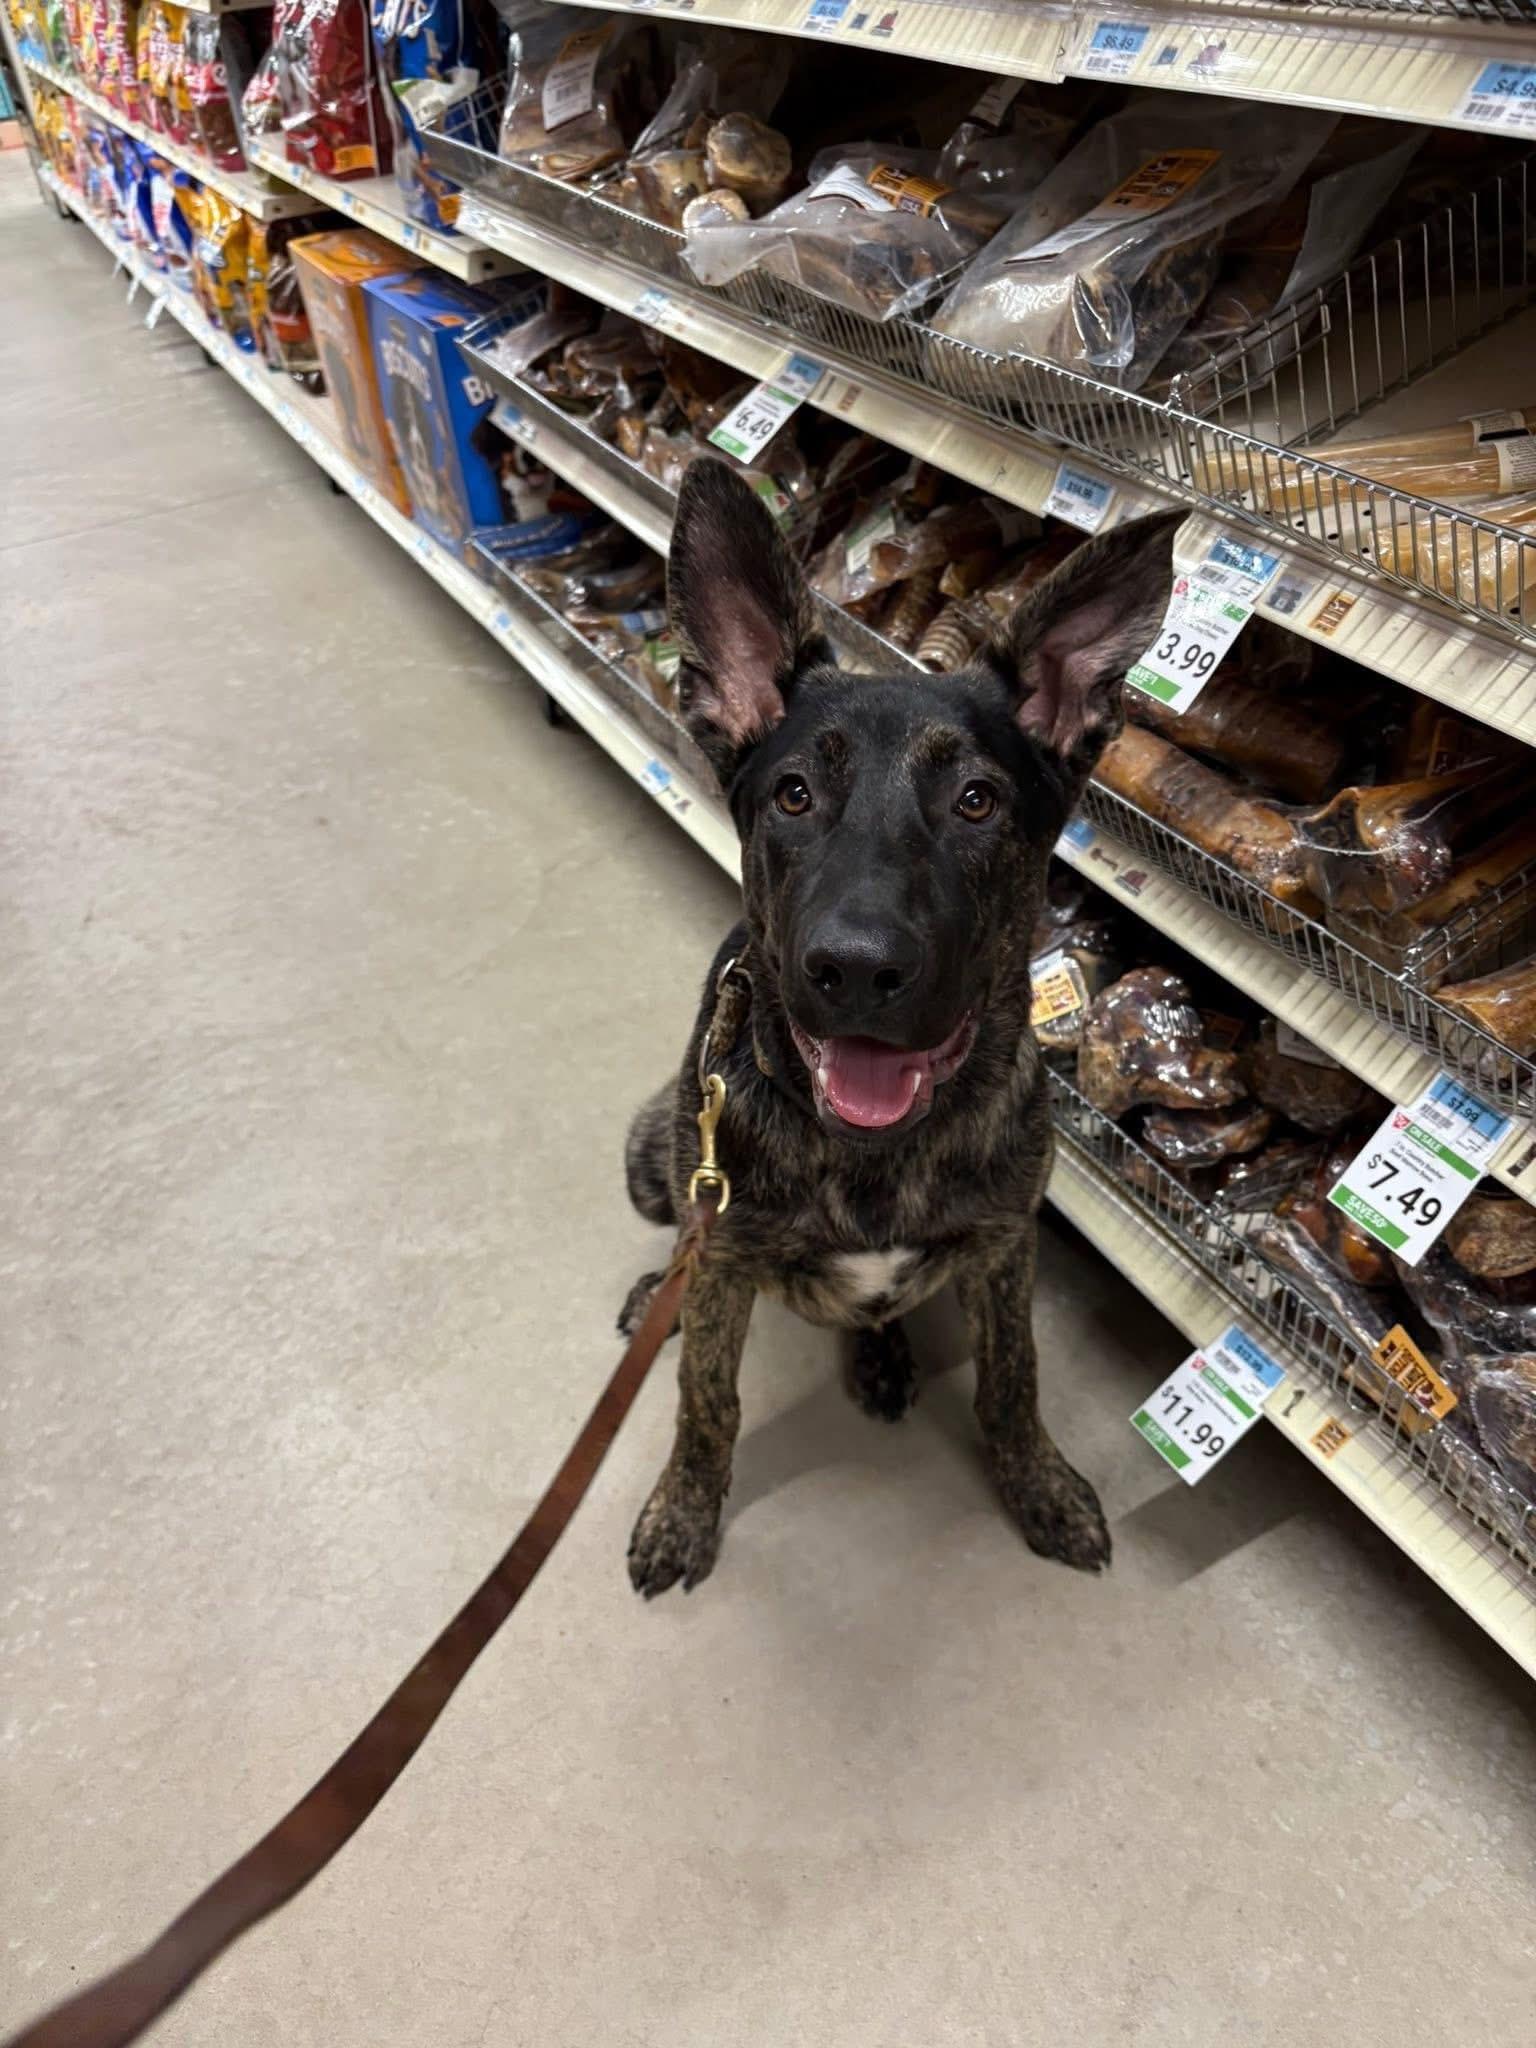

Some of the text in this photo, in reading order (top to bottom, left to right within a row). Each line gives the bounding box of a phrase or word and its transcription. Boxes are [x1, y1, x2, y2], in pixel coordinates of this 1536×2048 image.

[1448, 1096, 1480, 1124] $7.99
[1368, 1154, 1442, 1226] $7.49
[1161, 1385, 1225, 1457] $11.99
